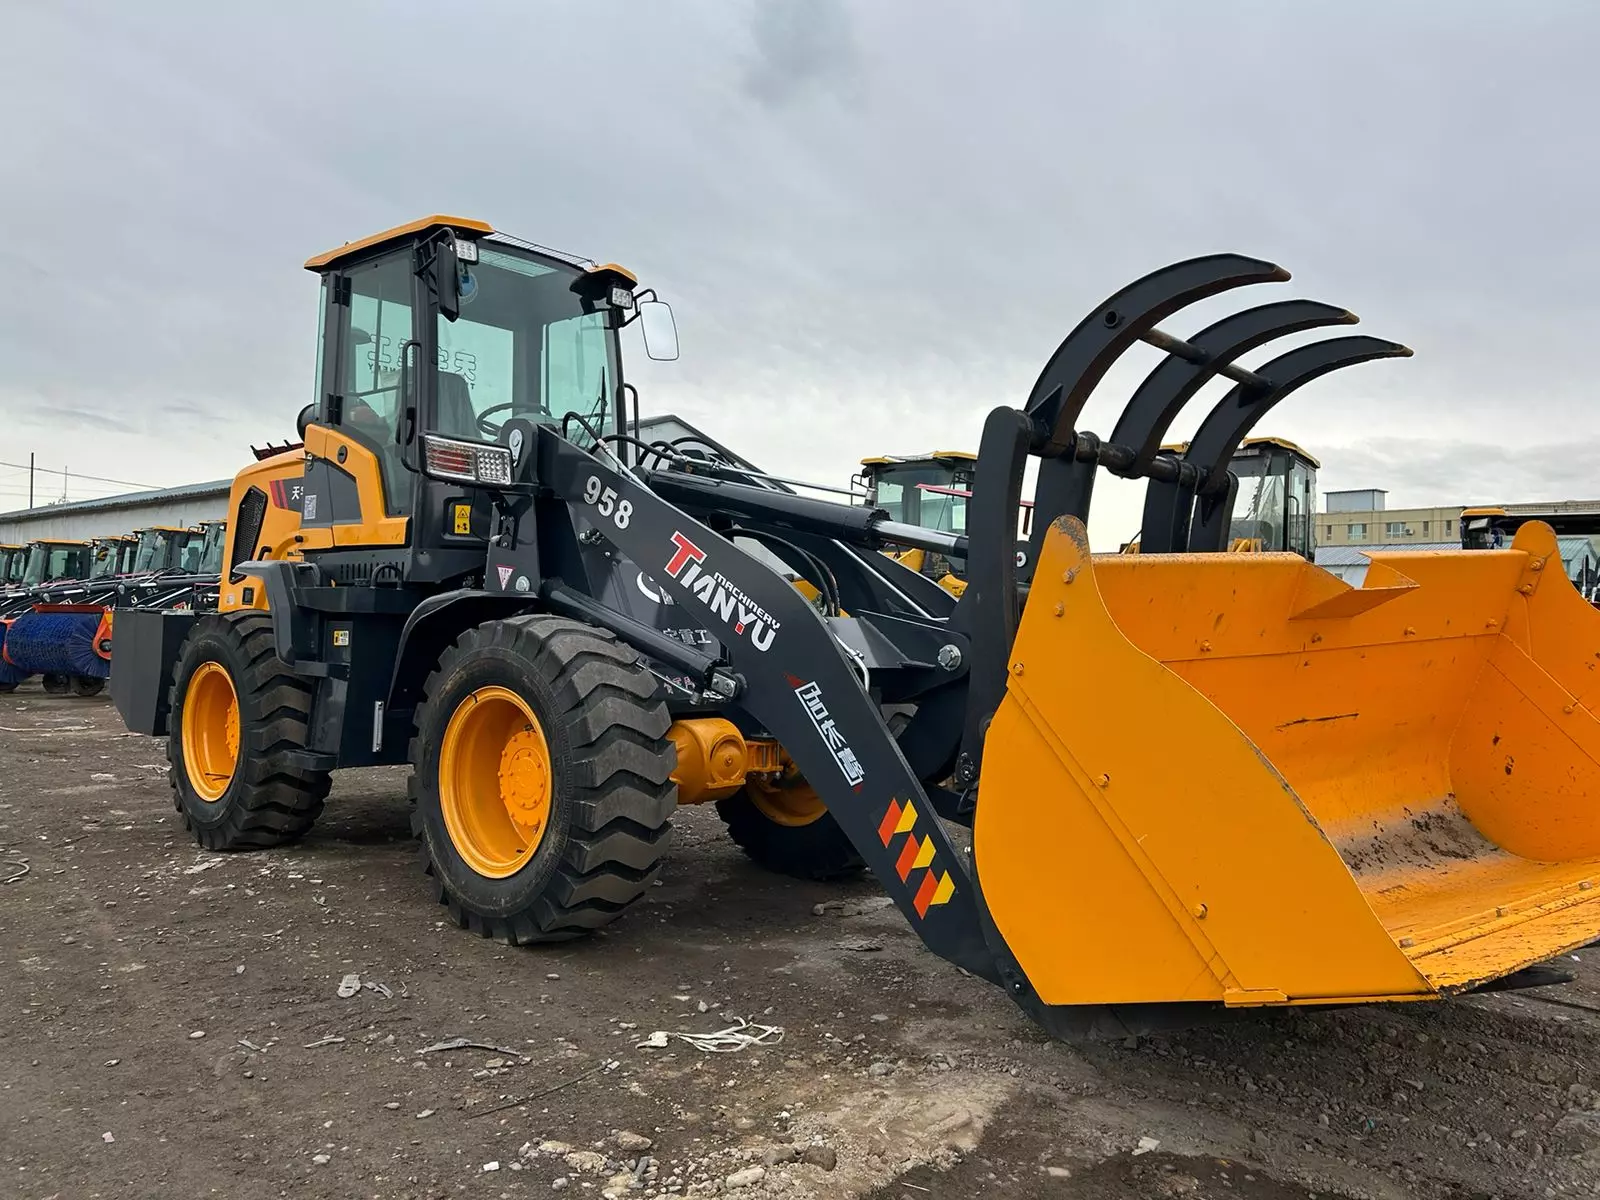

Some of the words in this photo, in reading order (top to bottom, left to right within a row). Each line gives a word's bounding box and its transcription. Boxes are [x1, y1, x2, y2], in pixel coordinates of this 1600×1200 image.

[583, 475, 633, 529] 958
[664, 530, 777, 652] TIANYU
[713, 571, 781, 630] MACHINERY
